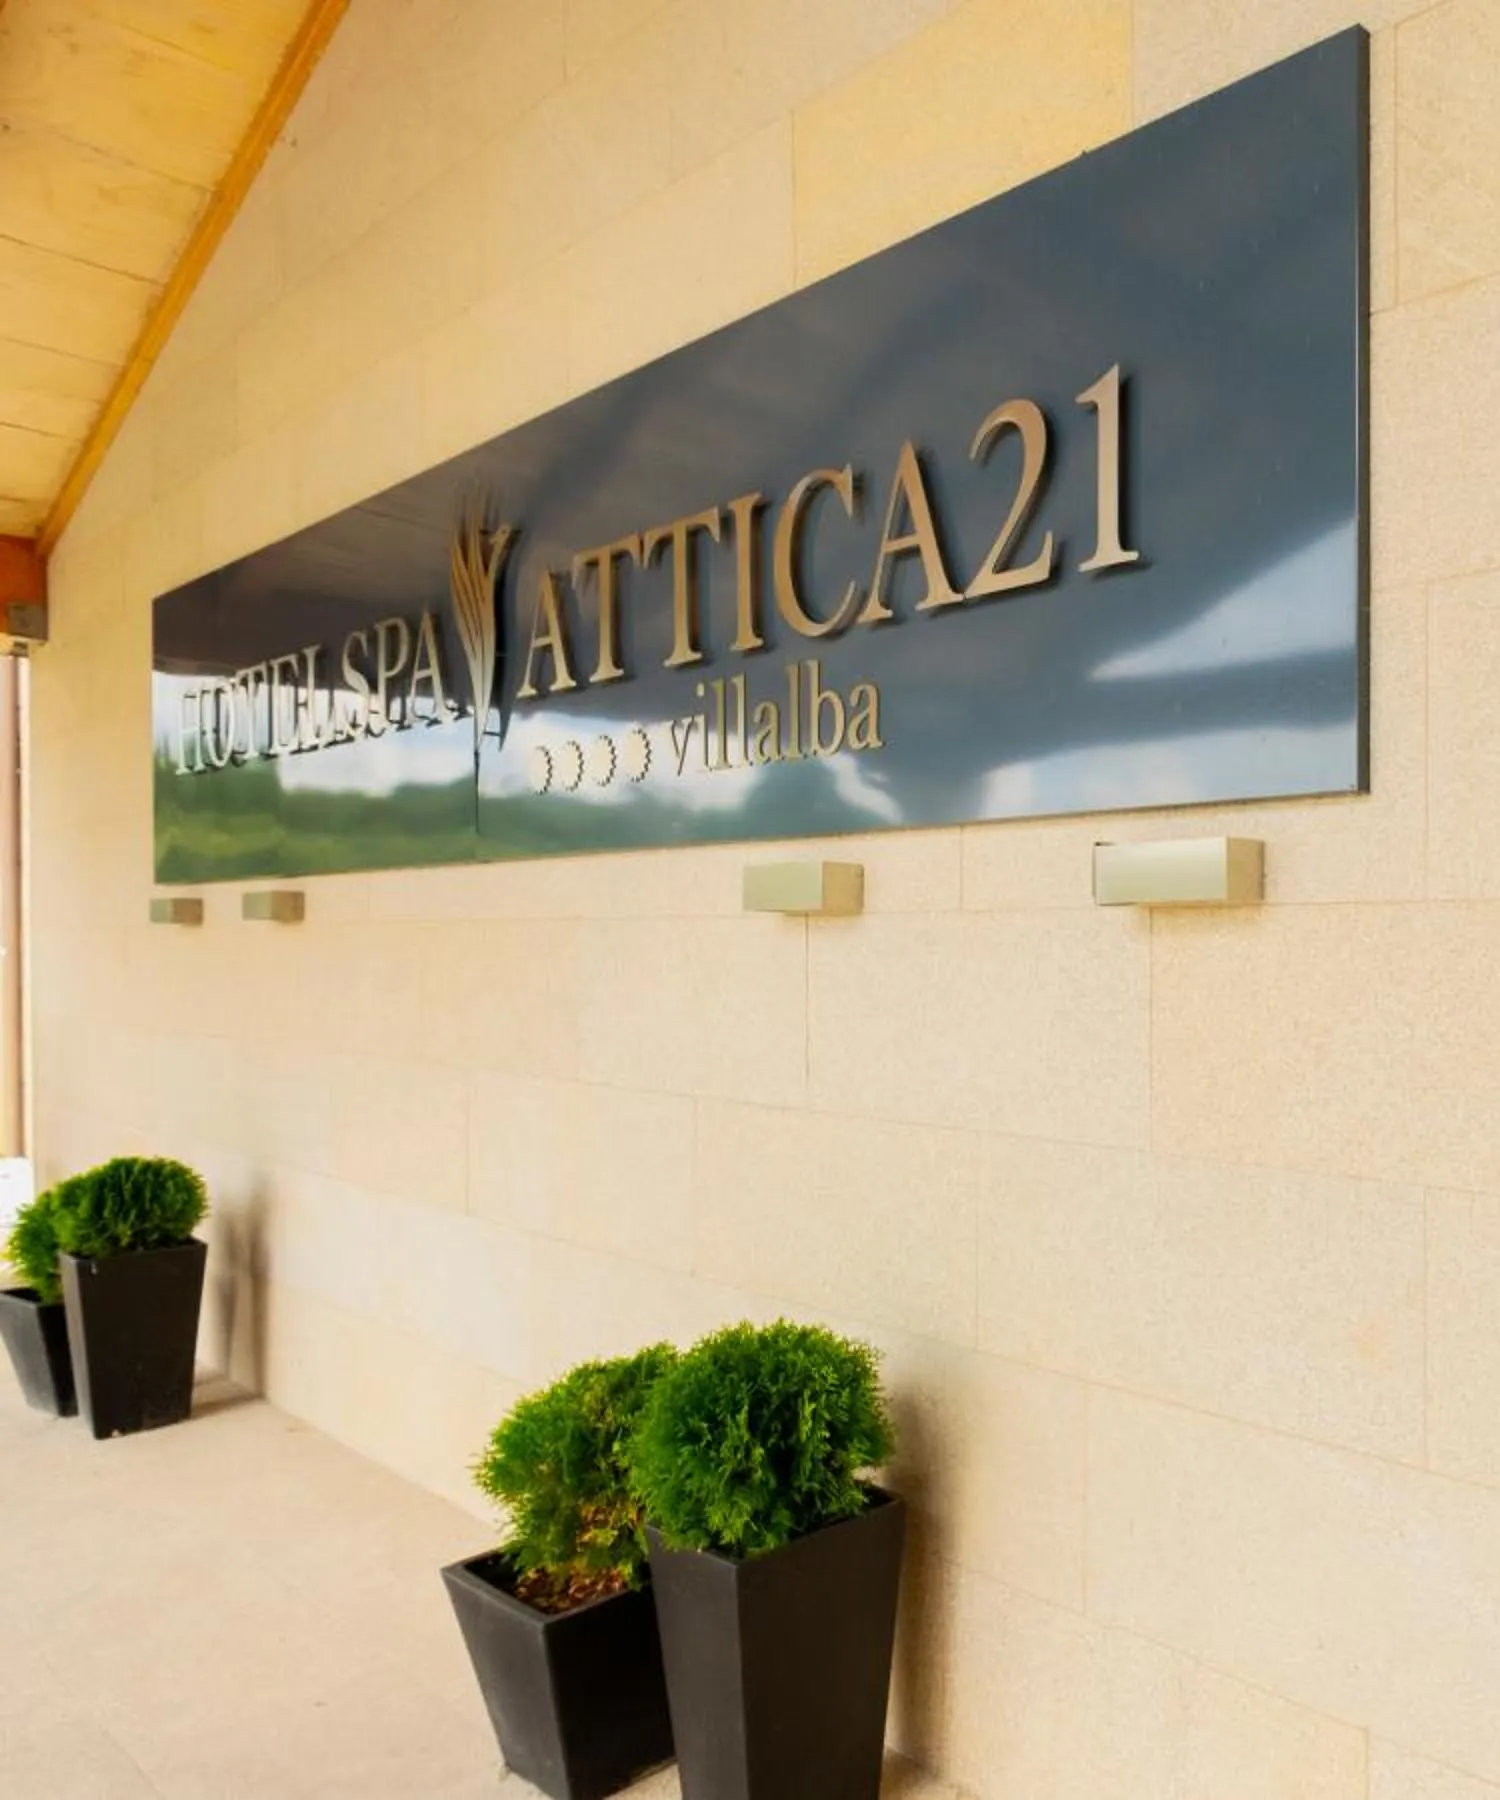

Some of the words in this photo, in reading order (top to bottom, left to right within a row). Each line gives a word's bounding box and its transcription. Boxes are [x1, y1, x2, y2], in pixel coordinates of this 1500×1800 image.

[175, 643, 330, 775] HOTEL
[342, 608, 455, 737] SPA
[517, 362, 1140, 698] ATTICA21
[666, 659, 883, 776] villalba
